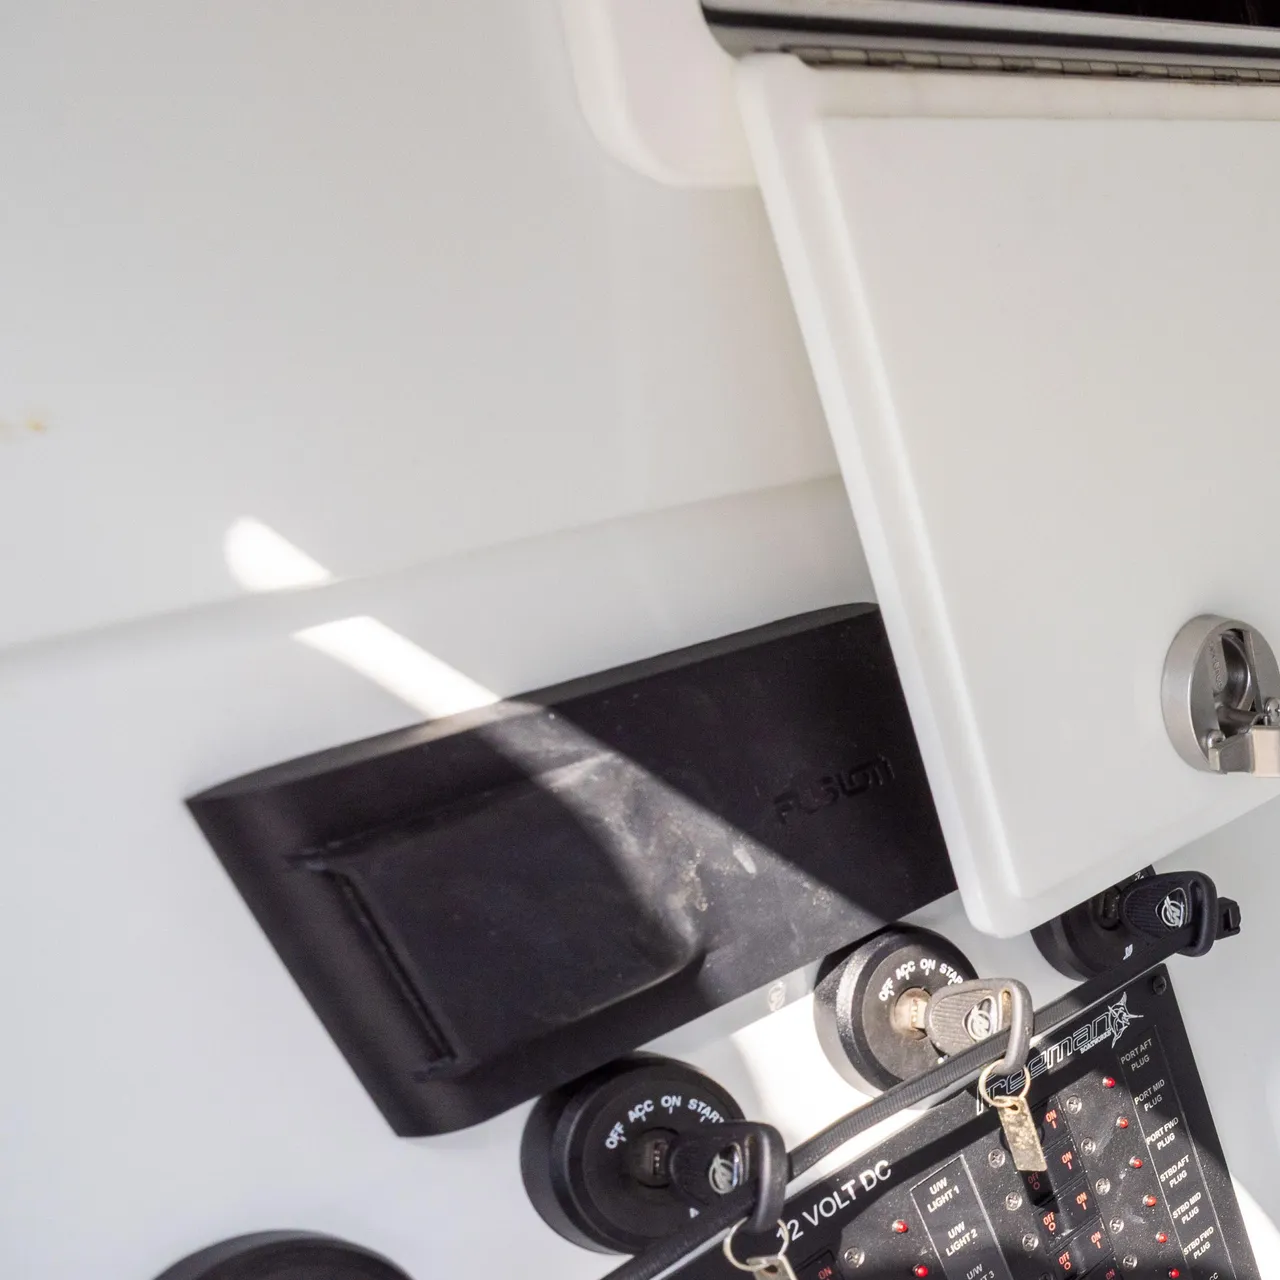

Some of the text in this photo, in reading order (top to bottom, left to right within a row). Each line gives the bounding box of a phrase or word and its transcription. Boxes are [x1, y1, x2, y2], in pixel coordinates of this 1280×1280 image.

[878, 958, 964, 1001] OFF ACC ON STAR
[1120, 1038, 1153, 1064] PORT AFT
[1130, 1055, 1150, 1071] PLUG
[604, 1121, 625, 1149] OFF
[628, 1099, 654, 1123] ACC
[661, 1095, 682, 1107] ON
[1146, 1117, 1179, 1146] PORT FWD
[1157, 1133, 1175, 1150] PLUG
[802, 1179, 857, 1227] VOLT
[859, 1159, 892, 1192] DC
[927, 1185, 960, 1213] LIGHT 1
[929, 1177, 947, 1195] U/W
[945, 1229, 978, 1257] LIGHT 2
[947, 1221, 965, 1239] U/W
[1183, 1226, 1214, 1255] STBD FWD
[1193, 1242, 1211, 1259] PLUG
[966, 1263, 983, 1280] U/W
[988, 1270, 995, 1280] 3
